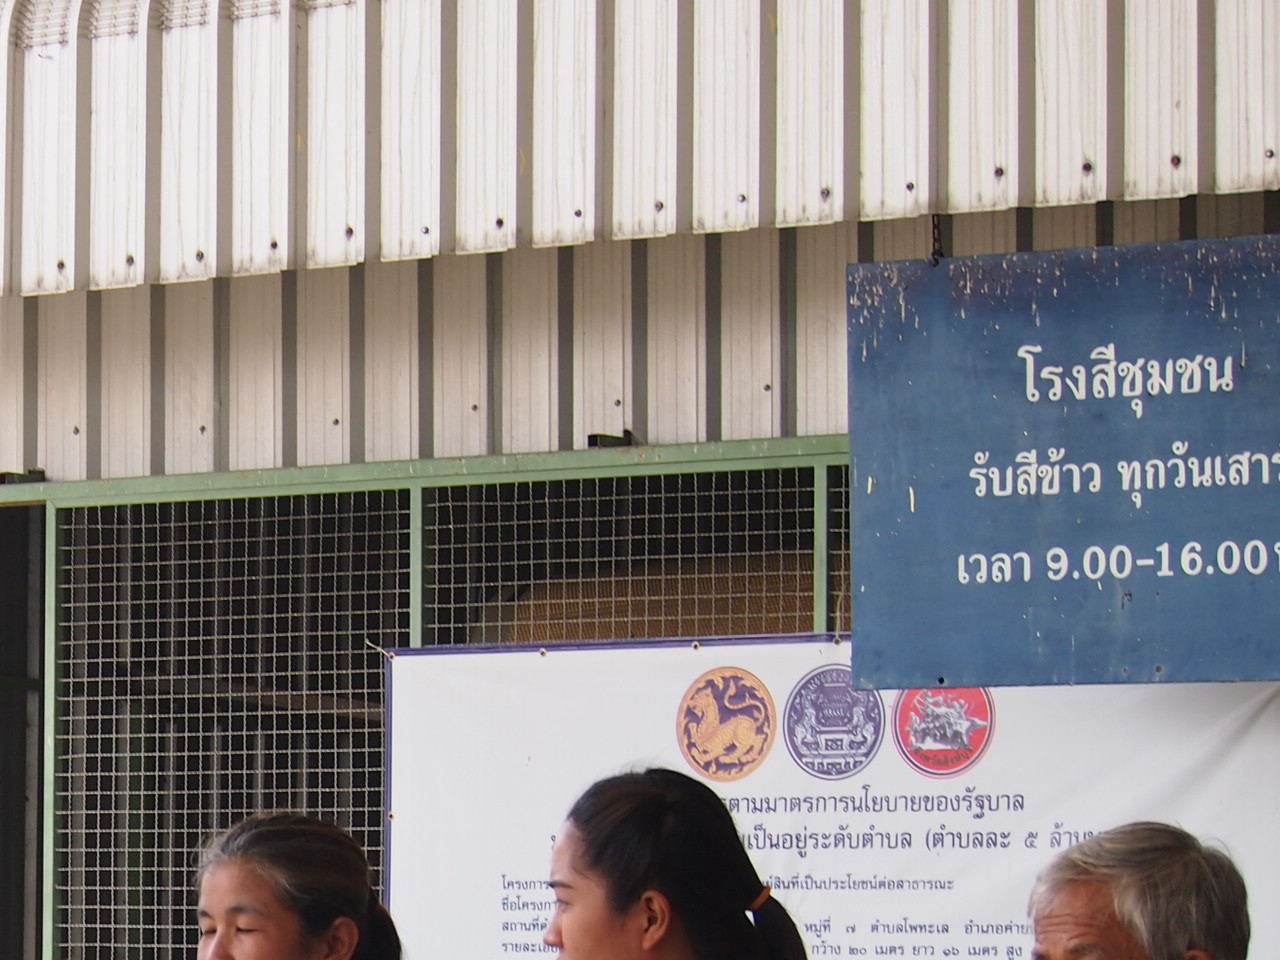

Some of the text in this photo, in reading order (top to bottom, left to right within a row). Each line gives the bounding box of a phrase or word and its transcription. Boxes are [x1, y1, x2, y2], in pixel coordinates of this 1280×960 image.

[1017, 343, 1234, 419] โรงสีชุมชน
[969, 448, 1102, 497] รับสีข้าว
[957, 552, 1031, 585] เวลา
[742, 824, 911, 858] เป็นอยู่ระดับตำบล
[875, 945, 904, 956] เมตร
[912, 945, 935, 956] ยาว
[968, 945, 998, 956] เมตร
